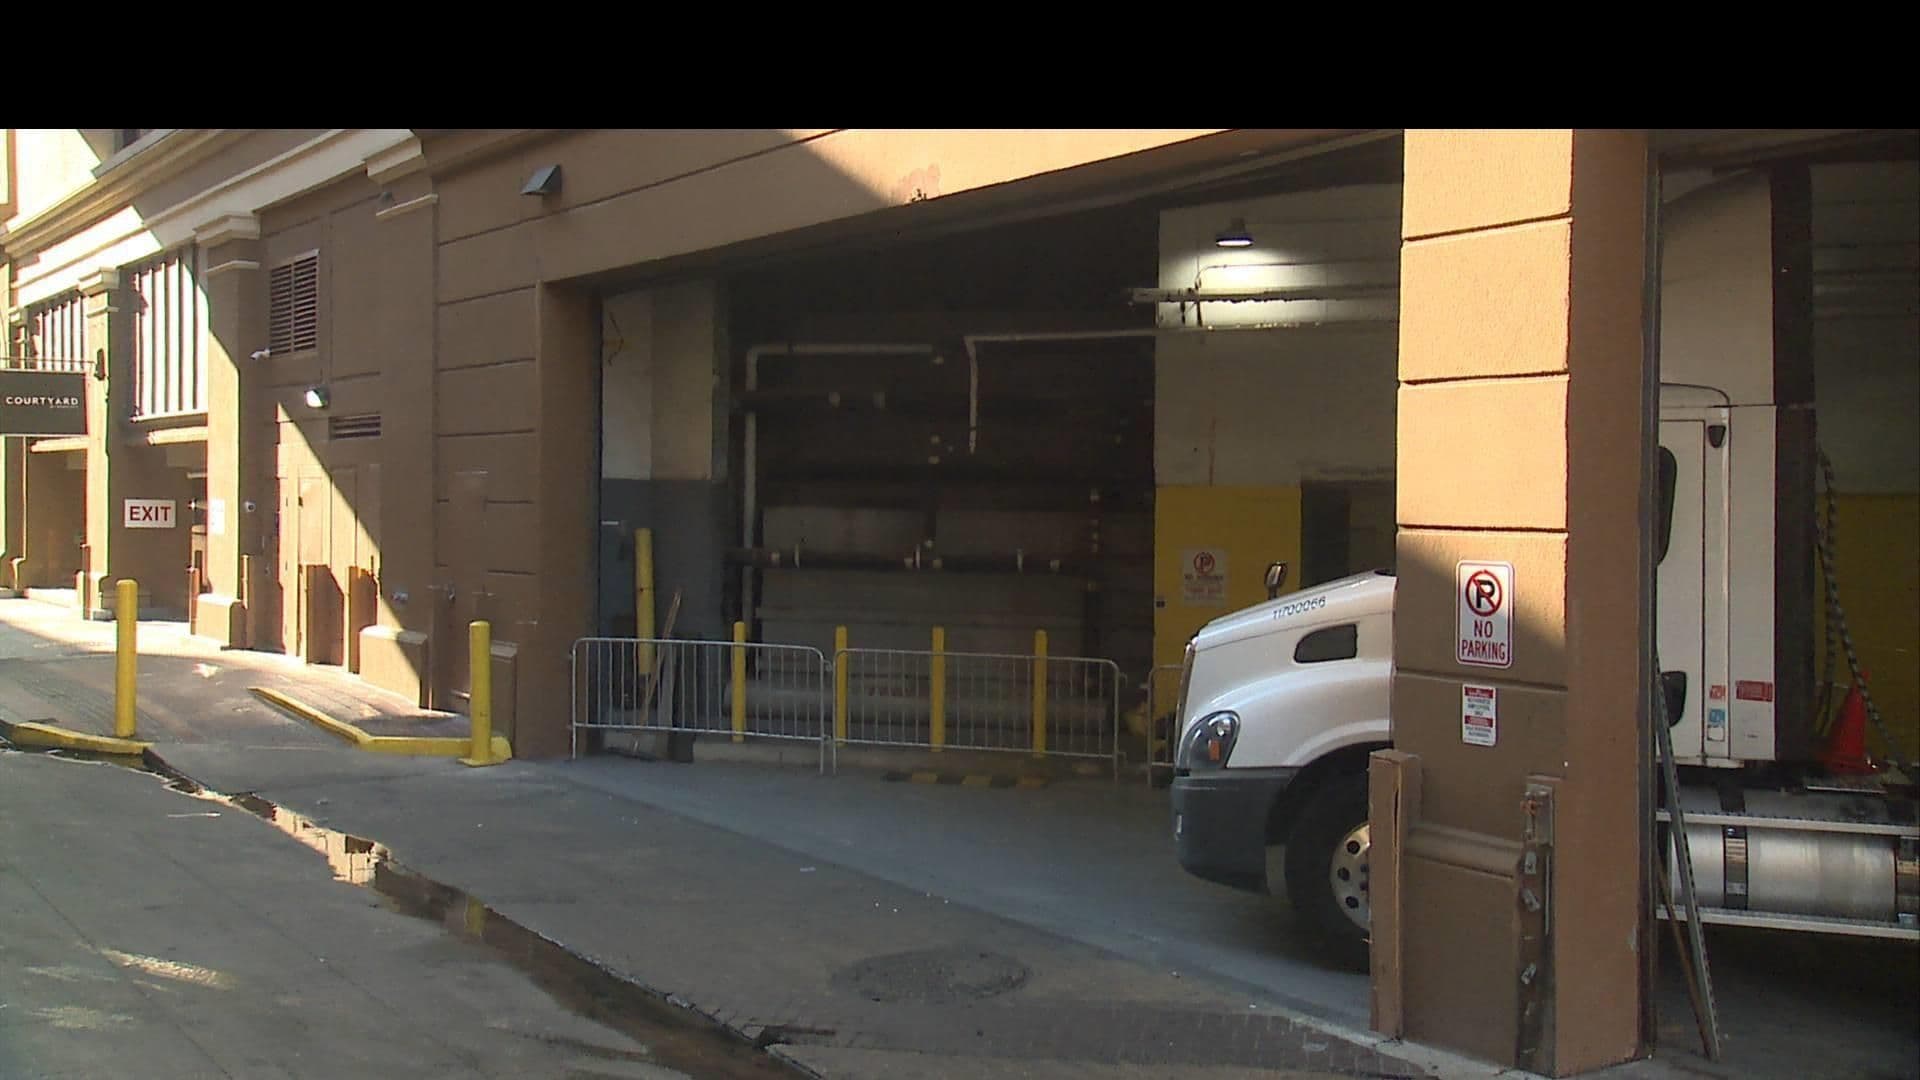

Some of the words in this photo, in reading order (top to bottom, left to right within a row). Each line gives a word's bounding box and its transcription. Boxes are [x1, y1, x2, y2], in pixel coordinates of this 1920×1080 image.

[6, 396, 79, 405] COURTYARD
[129, 505, 172, 521] EXIT
[1473, 620, 1494, 638] NO
[1461, 640, 1506, 661] PARKING
